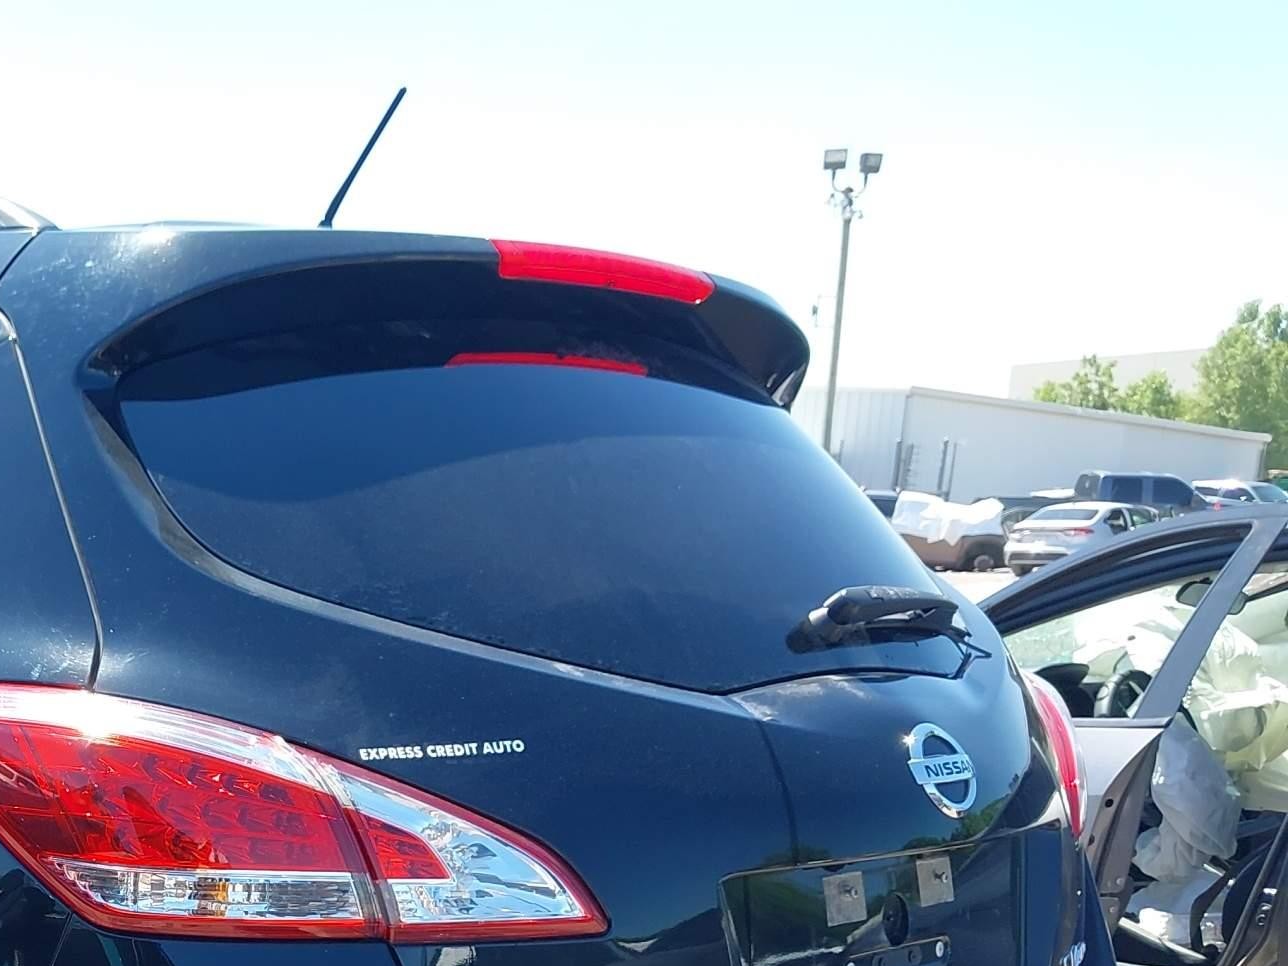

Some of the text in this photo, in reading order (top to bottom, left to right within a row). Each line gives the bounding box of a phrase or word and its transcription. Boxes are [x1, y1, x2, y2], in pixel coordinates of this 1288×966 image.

[359, 740, 525, 761] EXPRESS CREDIT AUTO
